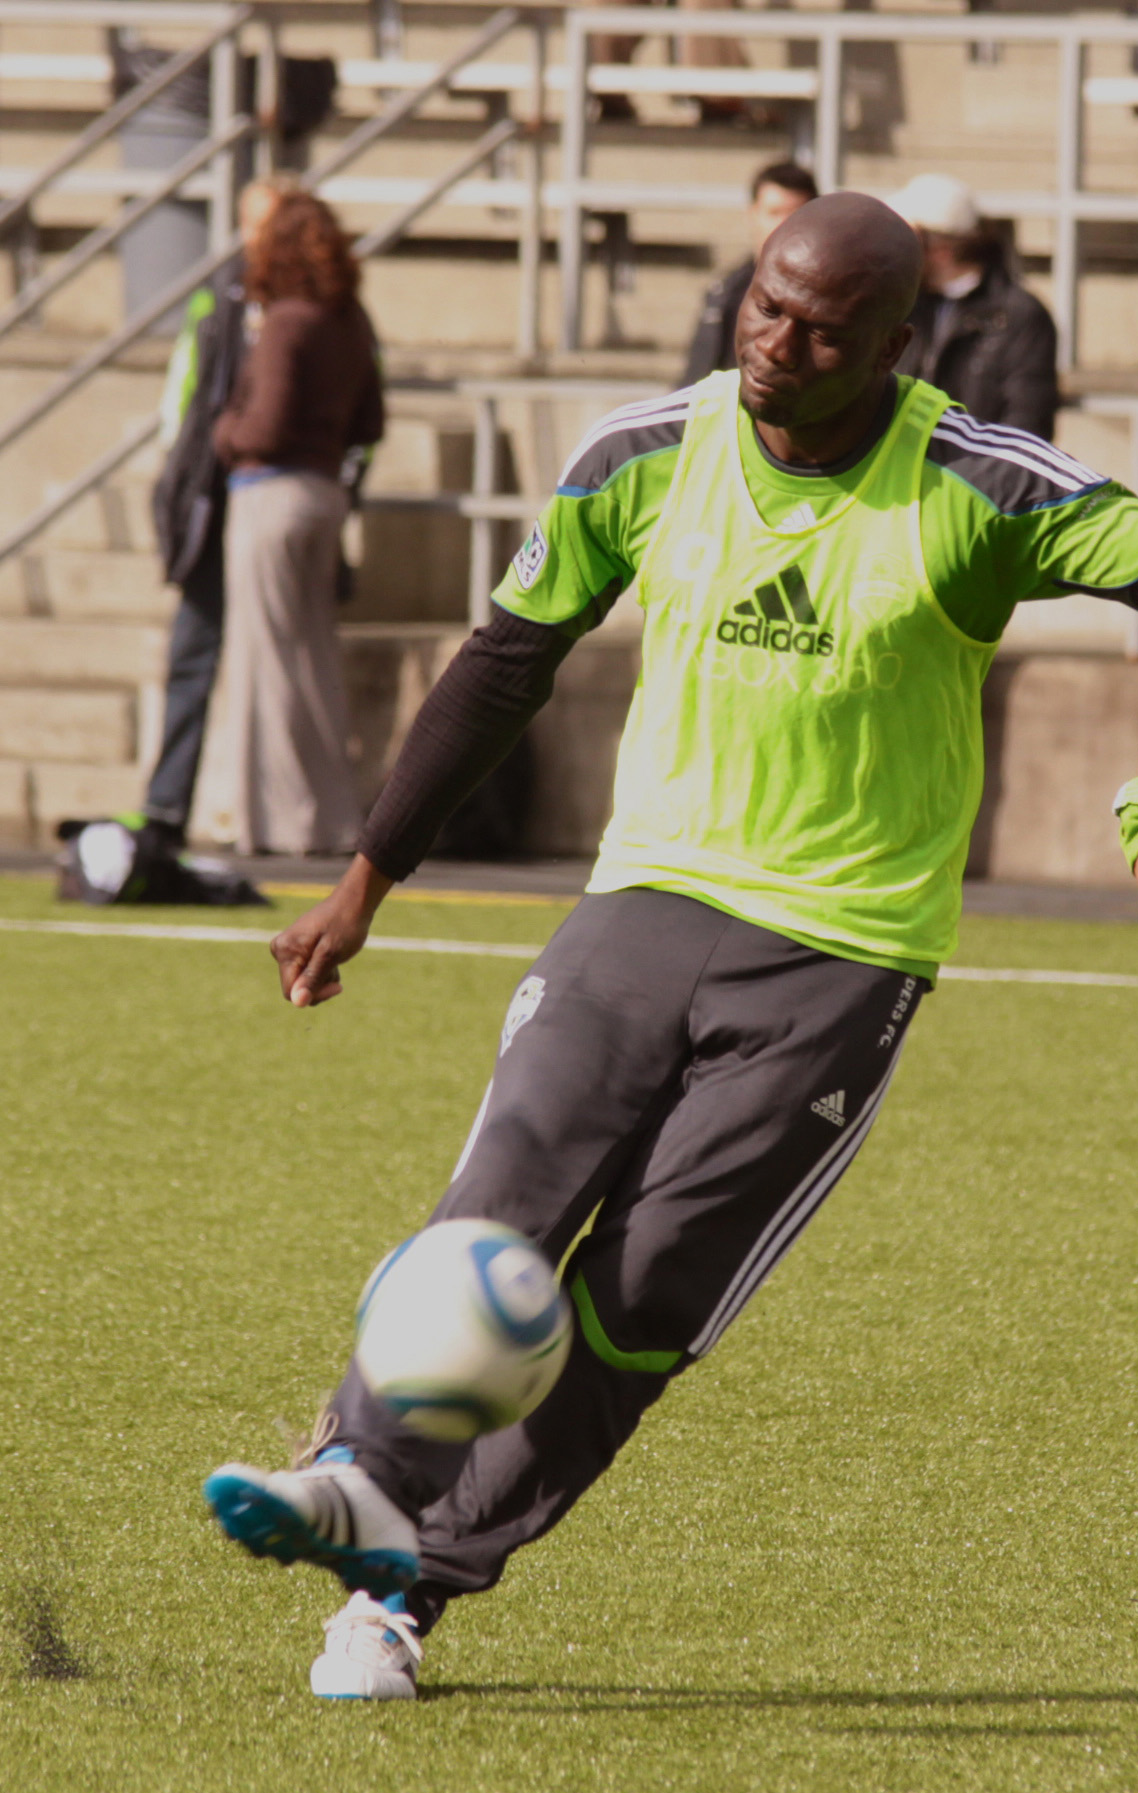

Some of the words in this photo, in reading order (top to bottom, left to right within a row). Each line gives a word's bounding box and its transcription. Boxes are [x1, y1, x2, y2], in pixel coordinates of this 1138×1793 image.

[717, 617, 834, 657] adidas
[891, 976, 917, 1022] DERS
[810, 1101, 846, 1127] adidas
